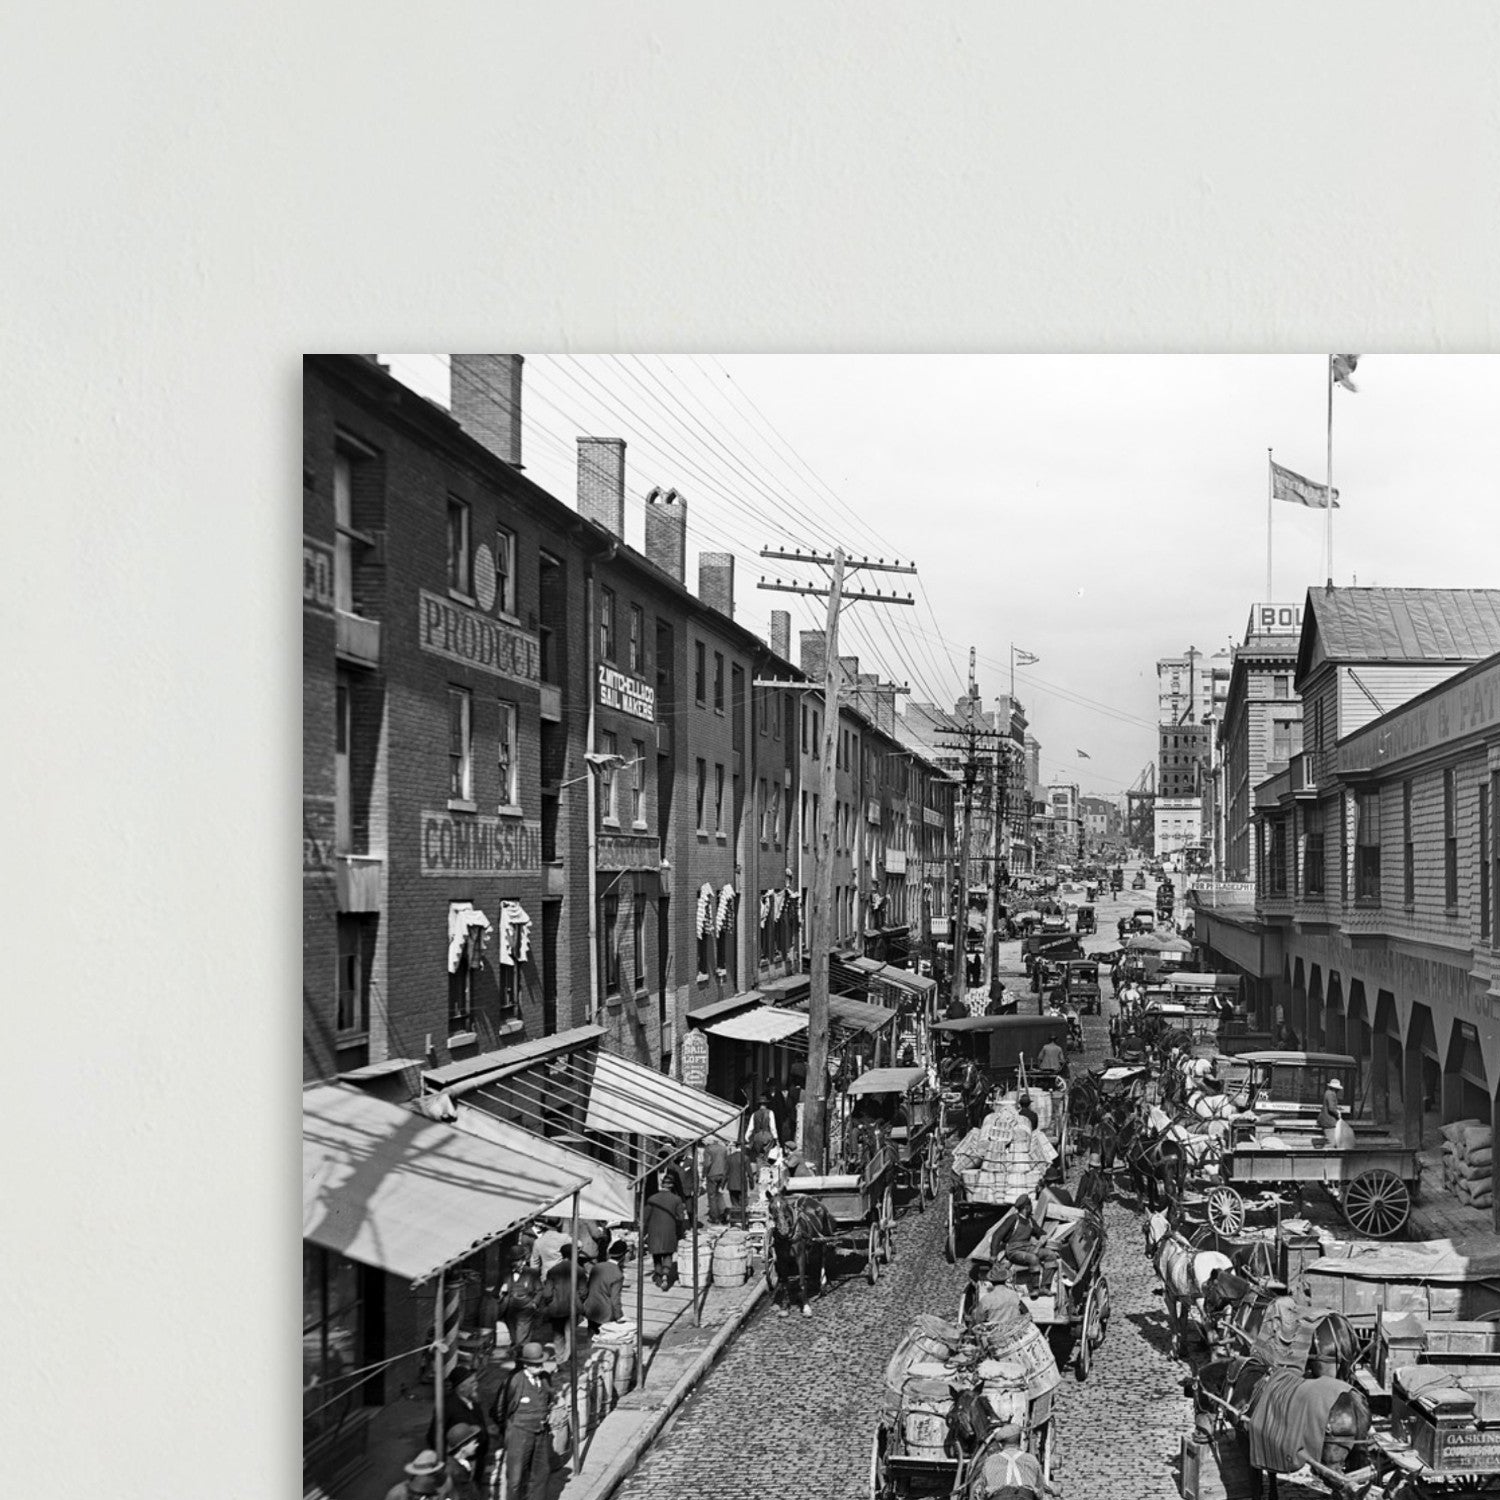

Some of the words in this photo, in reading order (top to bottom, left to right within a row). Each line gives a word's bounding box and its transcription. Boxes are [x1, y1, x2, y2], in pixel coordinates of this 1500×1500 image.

[426, 598, 539, 680] PRODUCE
[600, 685, 620, 709] SAIL
[425, 818, 541, 870] COMMISSION
[1447, 1433, 1500, 1444] GASKINS
